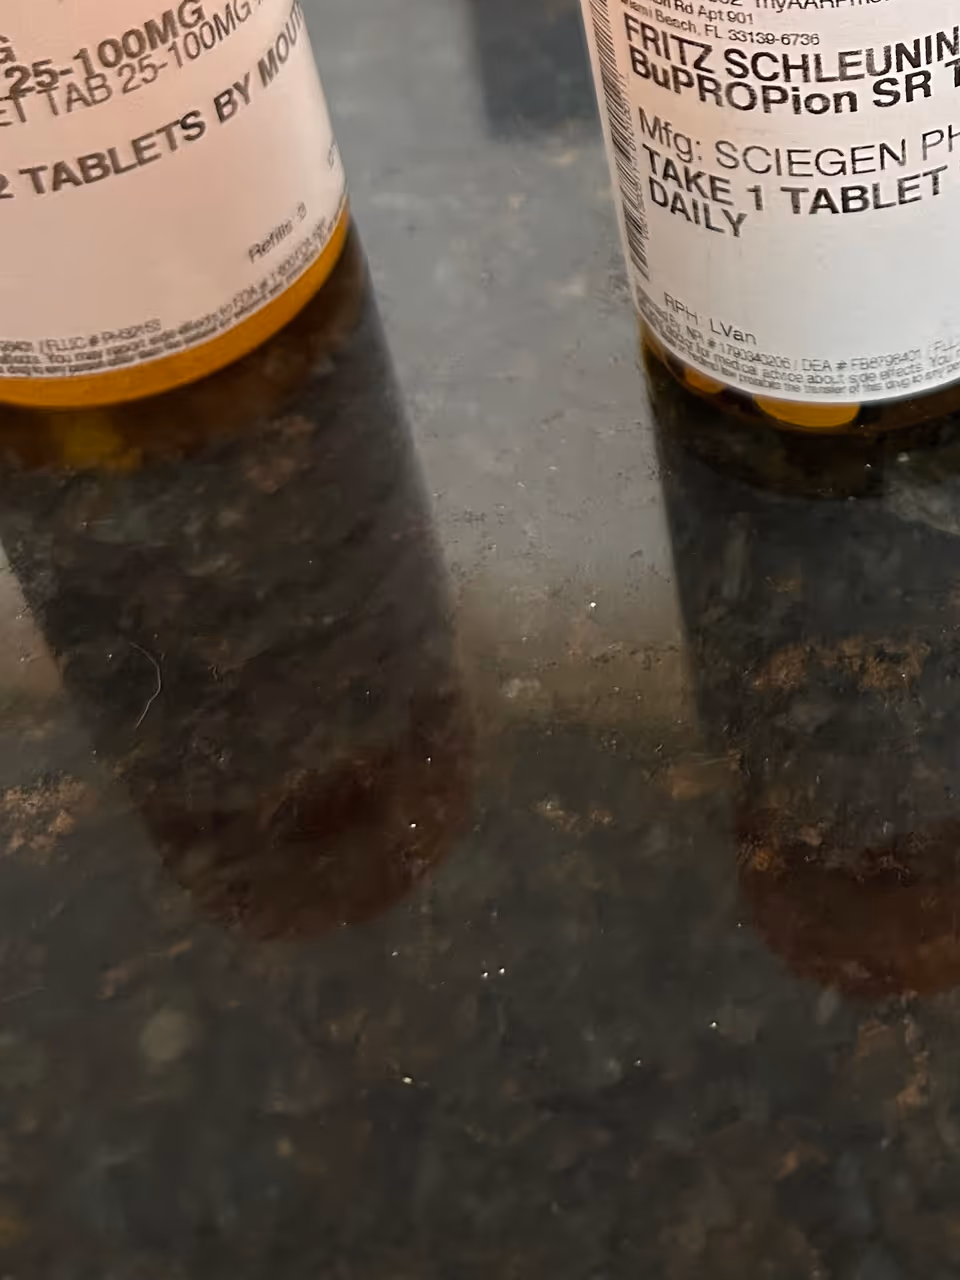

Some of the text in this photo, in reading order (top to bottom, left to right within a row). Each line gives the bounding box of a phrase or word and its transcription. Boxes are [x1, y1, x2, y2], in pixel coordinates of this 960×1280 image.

[623, 11, 715, 74] FRITZ
[697, 4, 725, 23] Apt
[727, 11, 753, 25] 901
[704, 23, 722, 39] FL
[728, 28, 820, 46] 33139-6736
[36, 72, 113, 117] TAB
[629, 44, 858, 115] BuPROPion
[872, 69, 932, 108] SR
[19, 110, 207, 194] TABLETS
[213, 72, 251, 124] BY
[638, 106, 702, 163] Mfg:
[714, 138, 907, 178] SCIEGEN
[641, 143, 734, 206] TAKE
[746, 184, 763, 211] 1
[780, 165, 948, 215] TABLET
[648, 175, 748, 238] DAILY
[801, 358, 832, 372] DEA
